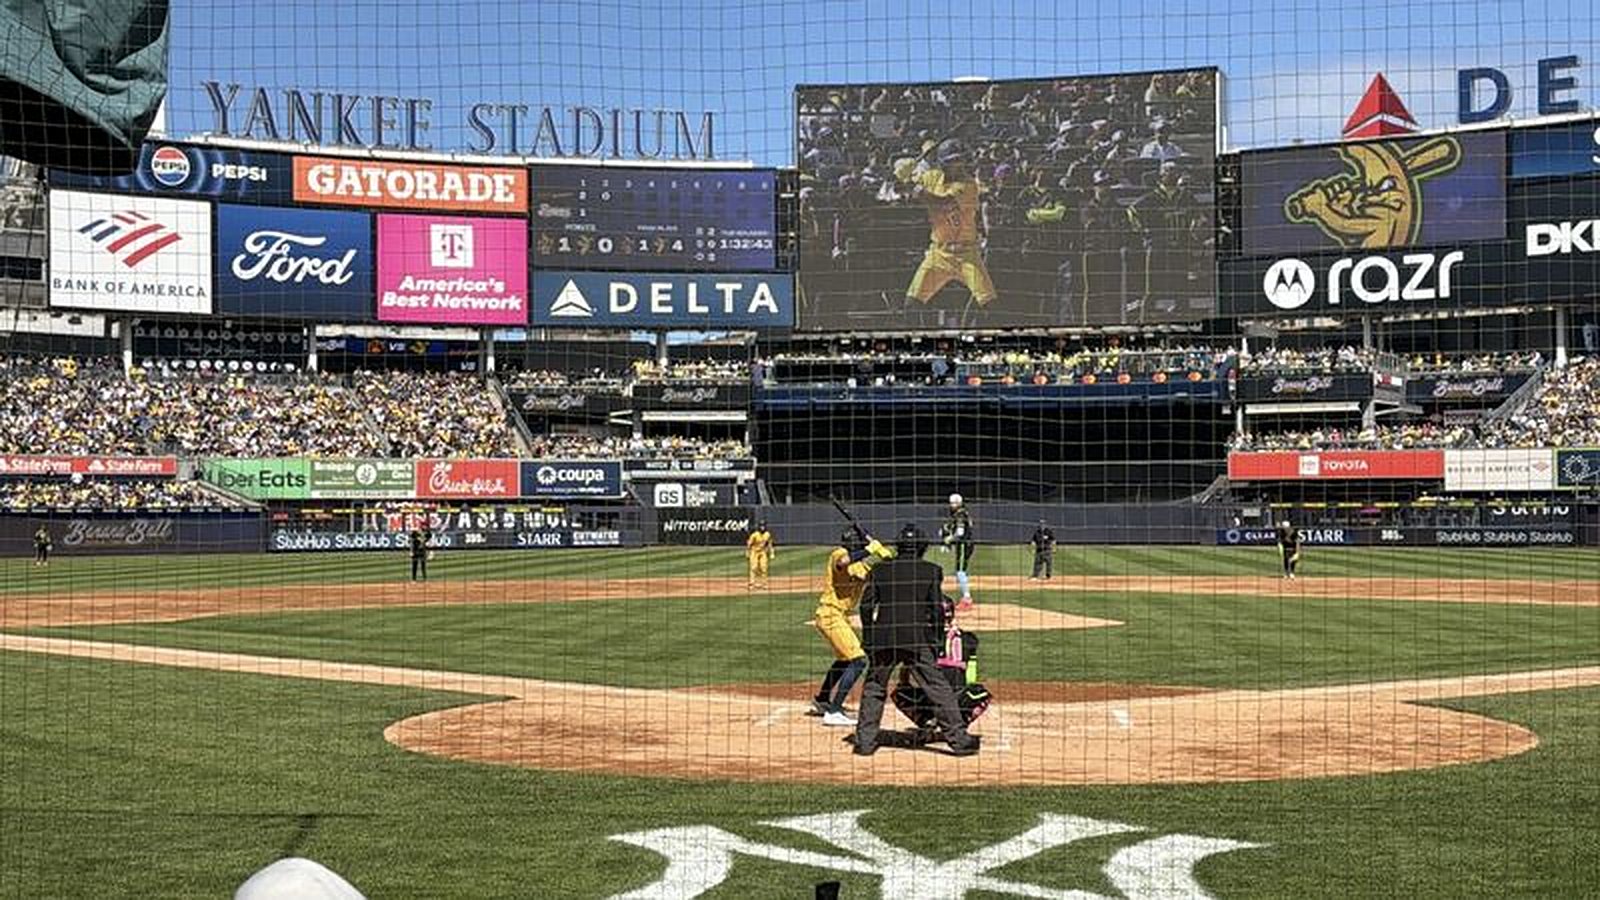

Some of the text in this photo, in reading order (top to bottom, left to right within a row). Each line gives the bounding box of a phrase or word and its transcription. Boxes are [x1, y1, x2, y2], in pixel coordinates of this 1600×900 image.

[200, 80, 716, 160] YANKEE STADIUM
[154, 161, 187, 172] PEPSI
[211, 163, 268, 182] PEPSI
[307, 163, 516, 204] GATORADE
[558, 236, 614, 254] 1 0
[639, 238, 684, 252] 1 4
[1526, 219, 1600, 257] DK
[232, 228, 360, 287] Ford
[400, 276, 506, 296] America's
[1327, 250, 1465, 305] razr
[53, 277, 207, 299] BANK OF AMERICA
[382, 290, 522, 313] Best Network
[608, 281, 779, 314] DELTA
[1323, 460, 1369, 471] TOYOTA
[259, 469, 307, 488] Eats
[557, 468, 605, 486] coupa
[659, 490, 680, 505] GS
[663, 518, 749, 533] NITTOTIRE.COM
[276, 533, 331, 550] StubHub
[335, 533, 390, 550] StubHub
[517, 532, 562, 546] STARR
[1296, 529, 1345, 543] STARR
